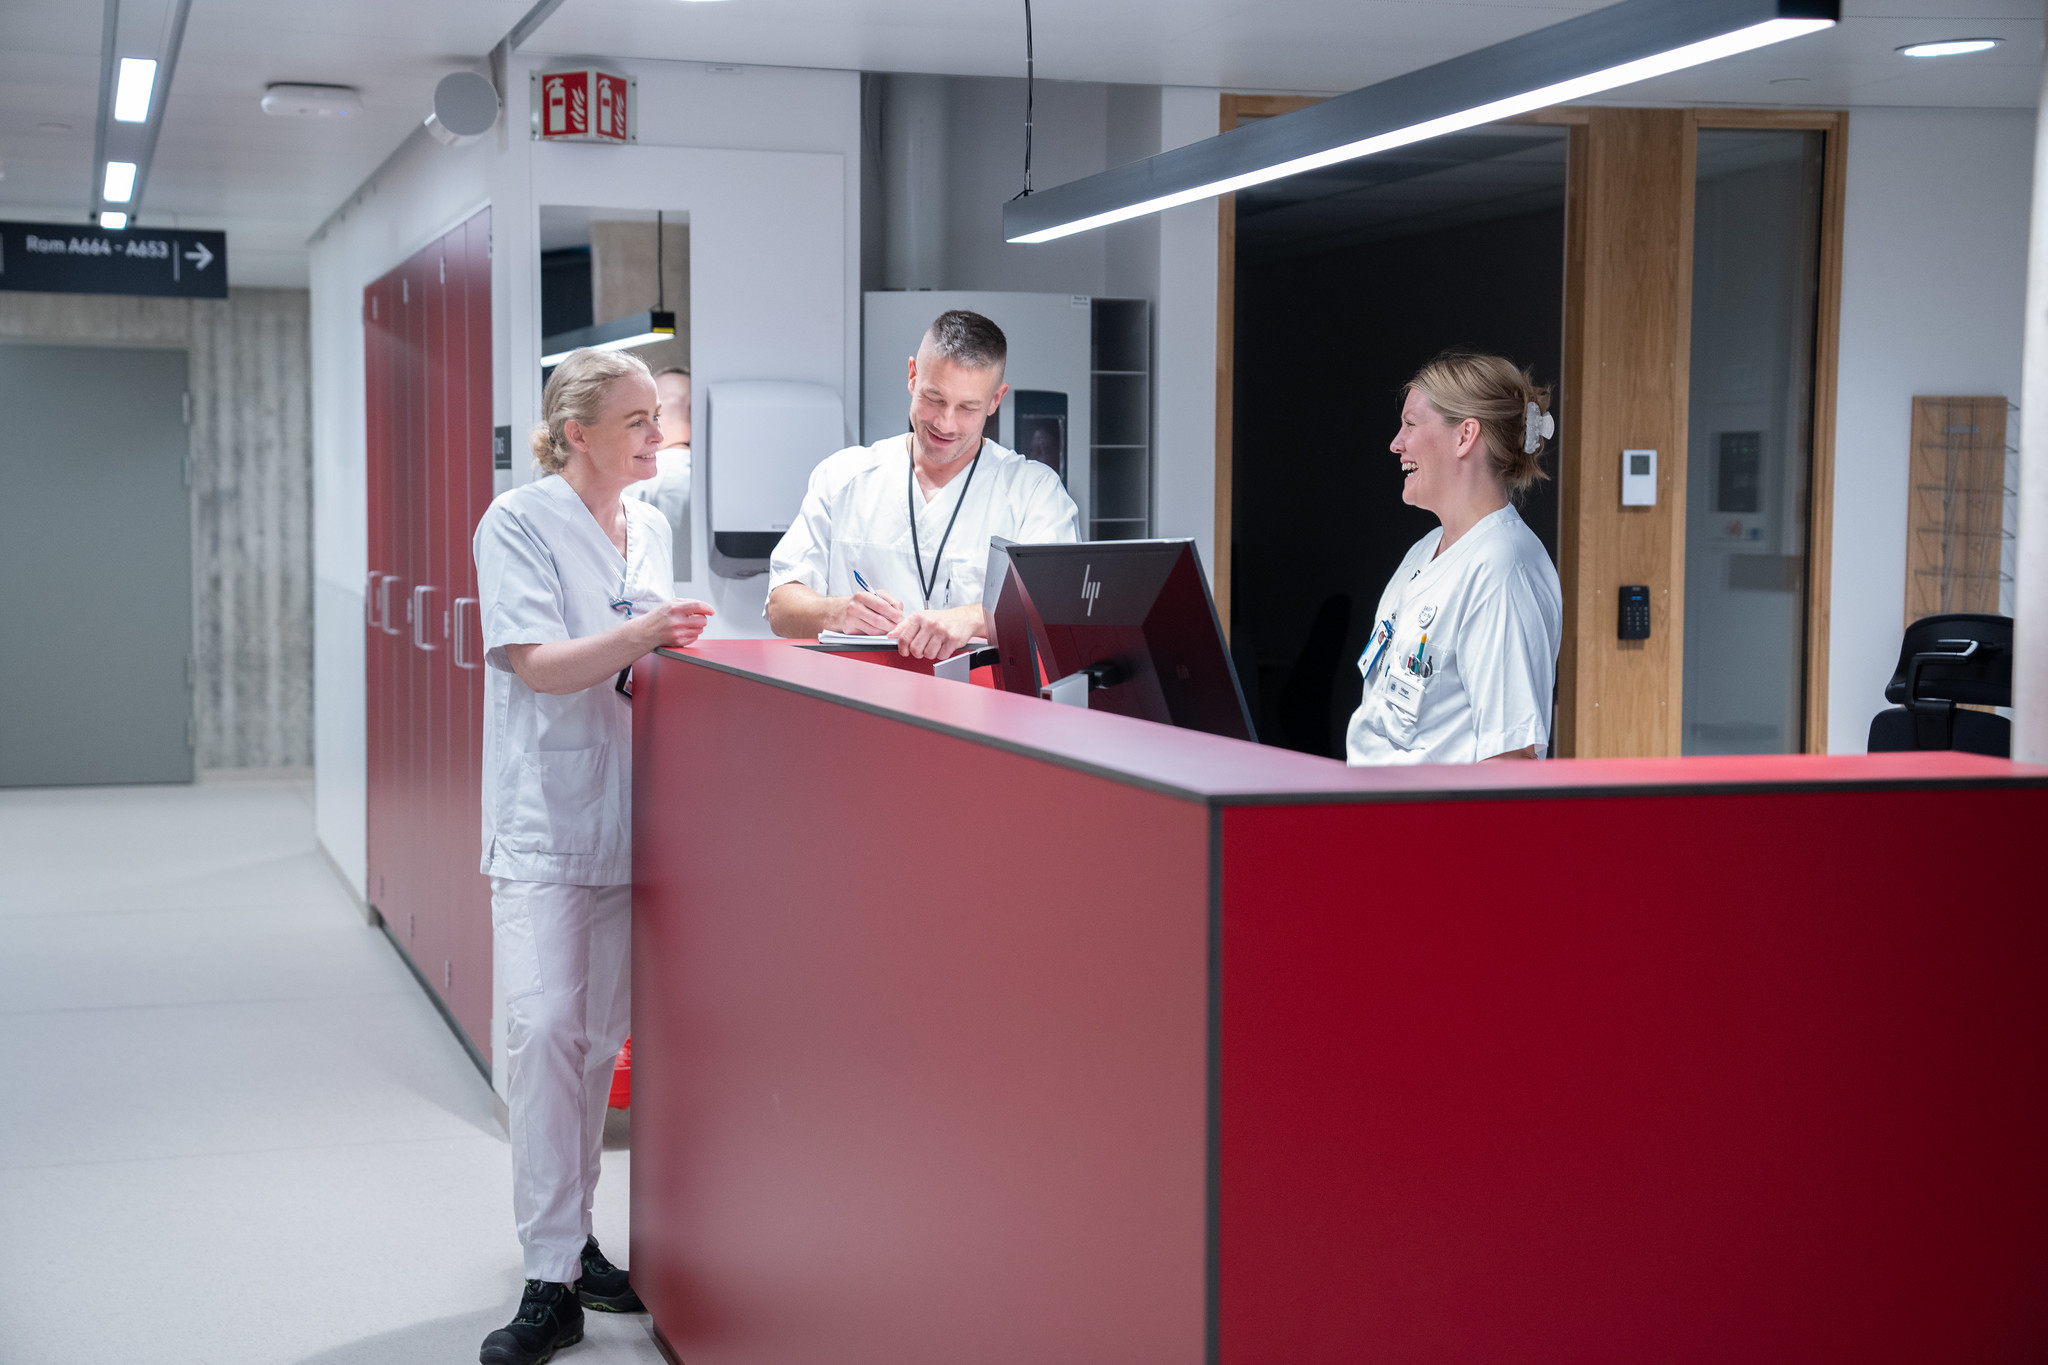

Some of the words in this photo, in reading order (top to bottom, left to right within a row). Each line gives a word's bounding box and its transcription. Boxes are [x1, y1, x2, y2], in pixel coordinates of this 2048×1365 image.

[26, 235, 67, 253] Rom
[68, 237, 112, 256] A664
[125, 239, 170, 259] A653
[1081, 564, 1101, 617] hp
